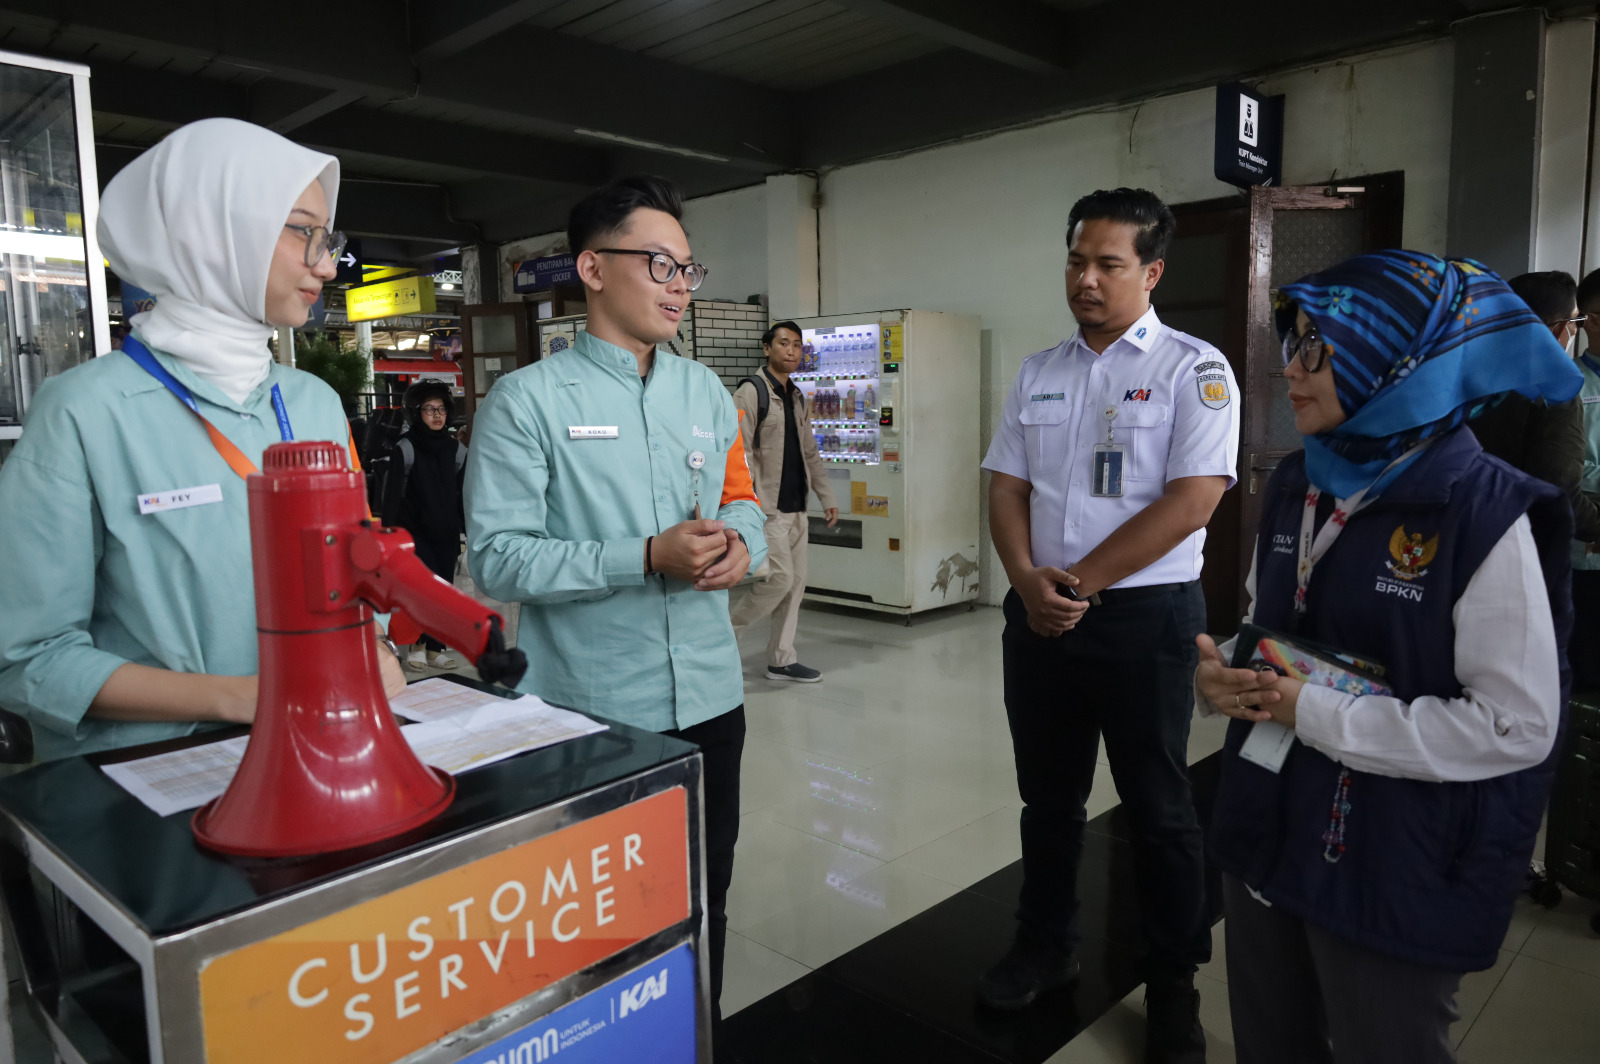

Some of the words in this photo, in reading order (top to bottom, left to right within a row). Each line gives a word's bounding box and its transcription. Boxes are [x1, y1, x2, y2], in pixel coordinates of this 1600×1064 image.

[537, 259, 563, 271] PENITIPAN
[552, 272, 571, 282] LOCKER
[1123, 389, 1152, 402] KAI
[144, 497, 160, 505] KAI
[172, 493, 191, 502] FEY
[1375, 581, 1423, 602] BPKN
[287, 832, 645, 1008] CUSTOMER
[343, 886, 616, 1041] SERVICE
[619, 968, 668, 1019] KAI
[560, 1018, 590, 1039] UNTUK
[560, 1020, 606, 1050] INDONESIA
